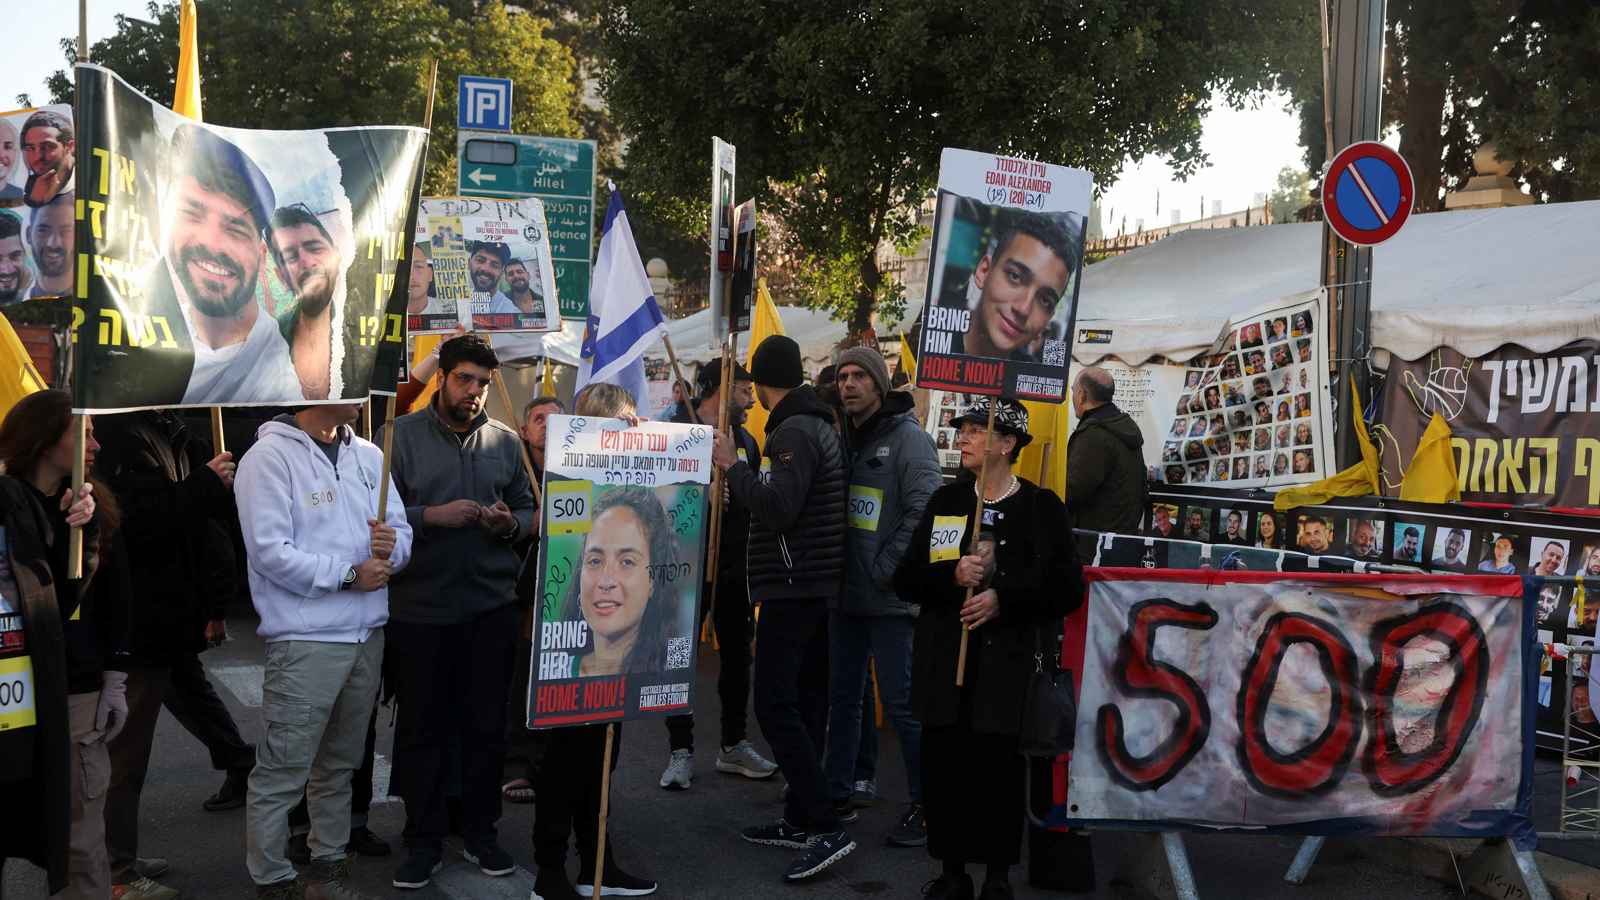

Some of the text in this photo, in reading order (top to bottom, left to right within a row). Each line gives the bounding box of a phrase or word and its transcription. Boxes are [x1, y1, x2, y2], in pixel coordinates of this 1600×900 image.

[995, 156, 1046, 177] עידן אלכסנדר
[986, 171, 1052, 193] EDAN ALEXANDER
[544, 202, 575, 214] העצמ
[1009, 190, 1025, 206] (20)
[432, 257, 466, 271] BRING
[434, 271, 467, 287] THEM
[437, 287, 471, 299] HOME
[928, 306, 970, 332] BRING
[925, 331, 952, 354] HIM
[923, 356, 1005, 386] HOME NOW!
[1016, 382, 1063, 397] FAMILIES FORUM
[601, 429, 668, 452] ענבר הימן (27)
[562, 452, 699, 472] נרצחה על ידי חמאס. עדיין חטופה בעזה.
[553, 497, 585, 518] 500
[850, 499, 875, 516] 500
[931, 529, 959, 547] 500
[540, 620, 587, 650] BRING
[538, 652, 569, 680] HER
[536, 677, 625, 713] HOME NOW!
[639, 690, 689, 708] FAMILIES FORUM
[1097, 598, 1489, 797] 500
